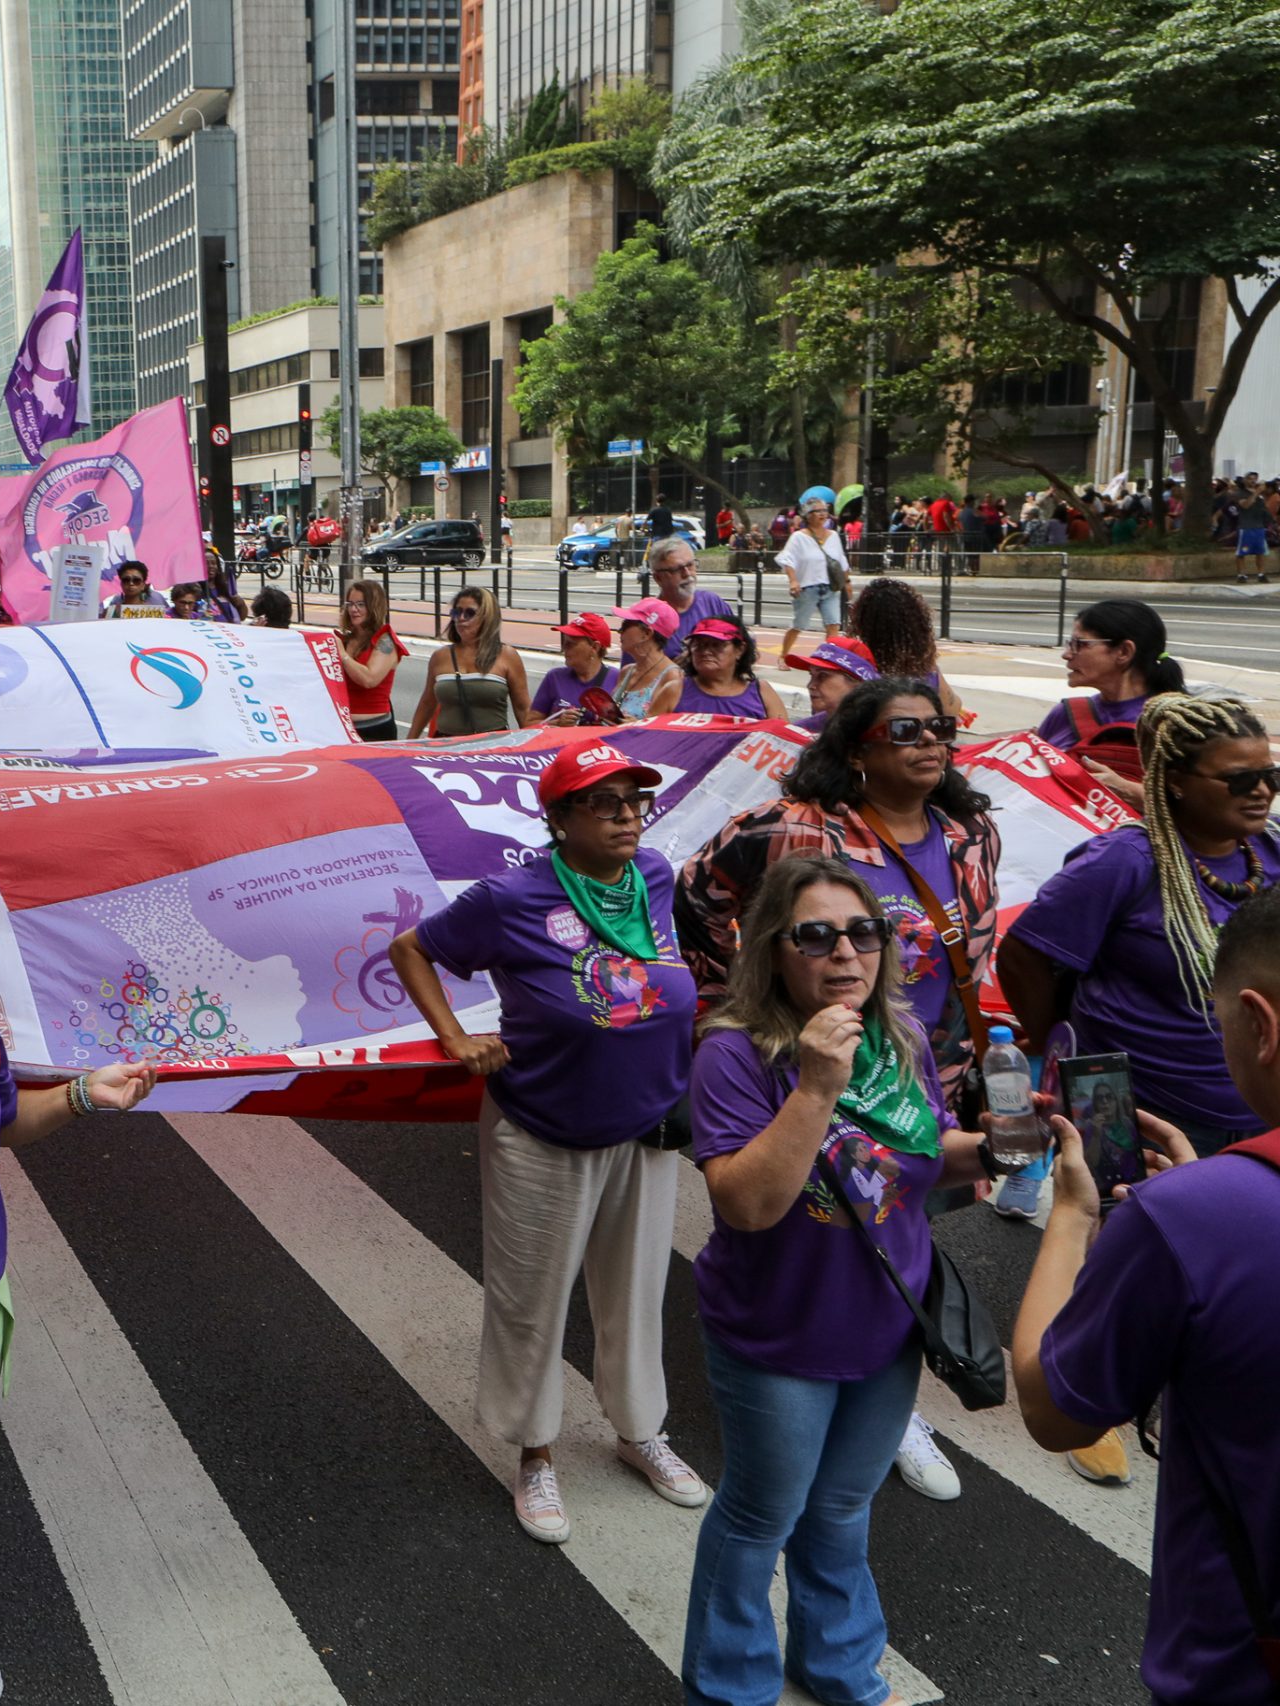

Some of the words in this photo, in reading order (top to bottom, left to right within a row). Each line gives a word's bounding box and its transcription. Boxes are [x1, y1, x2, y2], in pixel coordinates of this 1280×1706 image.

[312, 641, 337, 680] CUT
[326, 637, 340, 665] PAULO
[576, 745, 626, 767] CUT
[9, 776, 209, 810] CONTRAF
[304, 849, 413, 876] TRABALHADORA
[237, 868, 301, 892] QUÍMICA
[296, 881, 317, 893] DA
[319, 863, 400, 888] SECRETARIA
[207, 888, 224, 902] SP
[234, 887, 293, 911] MULHER
